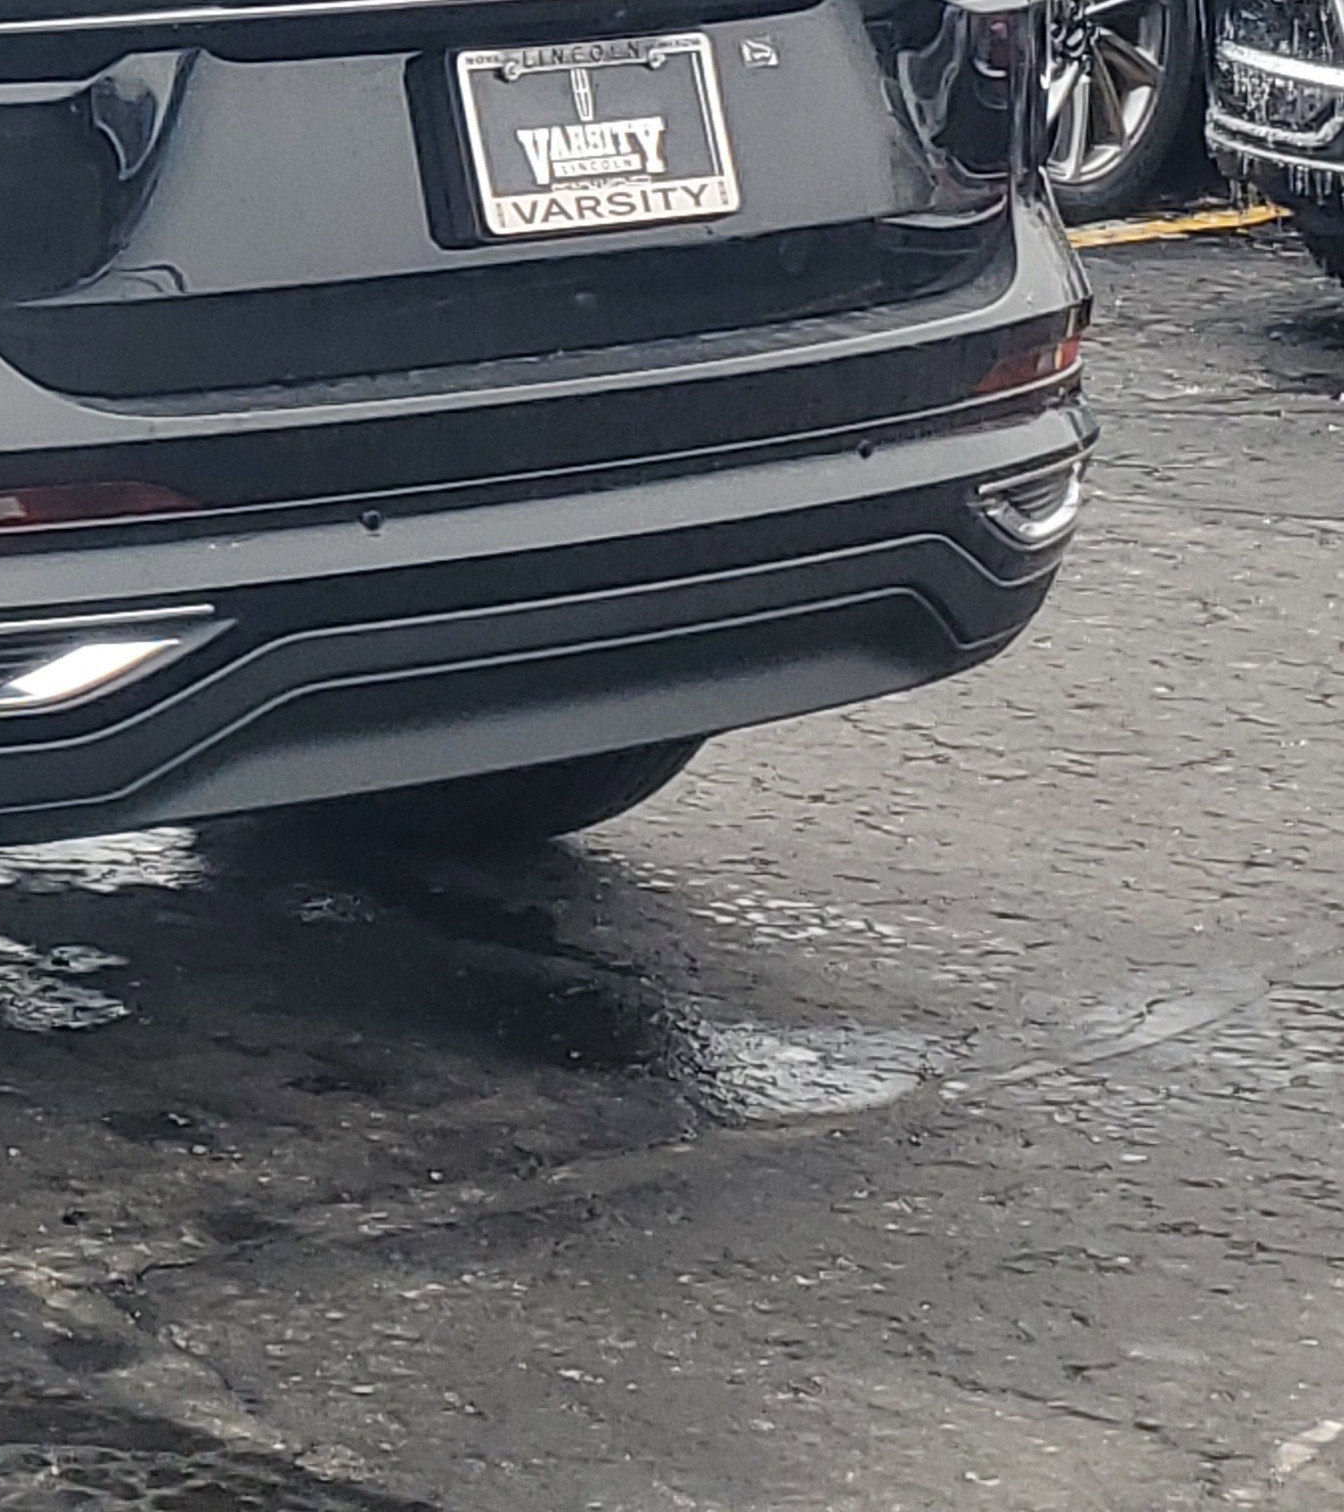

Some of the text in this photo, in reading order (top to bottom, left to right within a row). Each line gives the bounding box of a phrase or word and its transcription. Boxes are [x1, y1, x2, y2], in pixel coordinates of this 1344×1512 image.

[516, 116, 665, 185] VARSITY
[561, 159, 633, 175] LINCOLN
[512, 183, 710, 225] VARSITY
